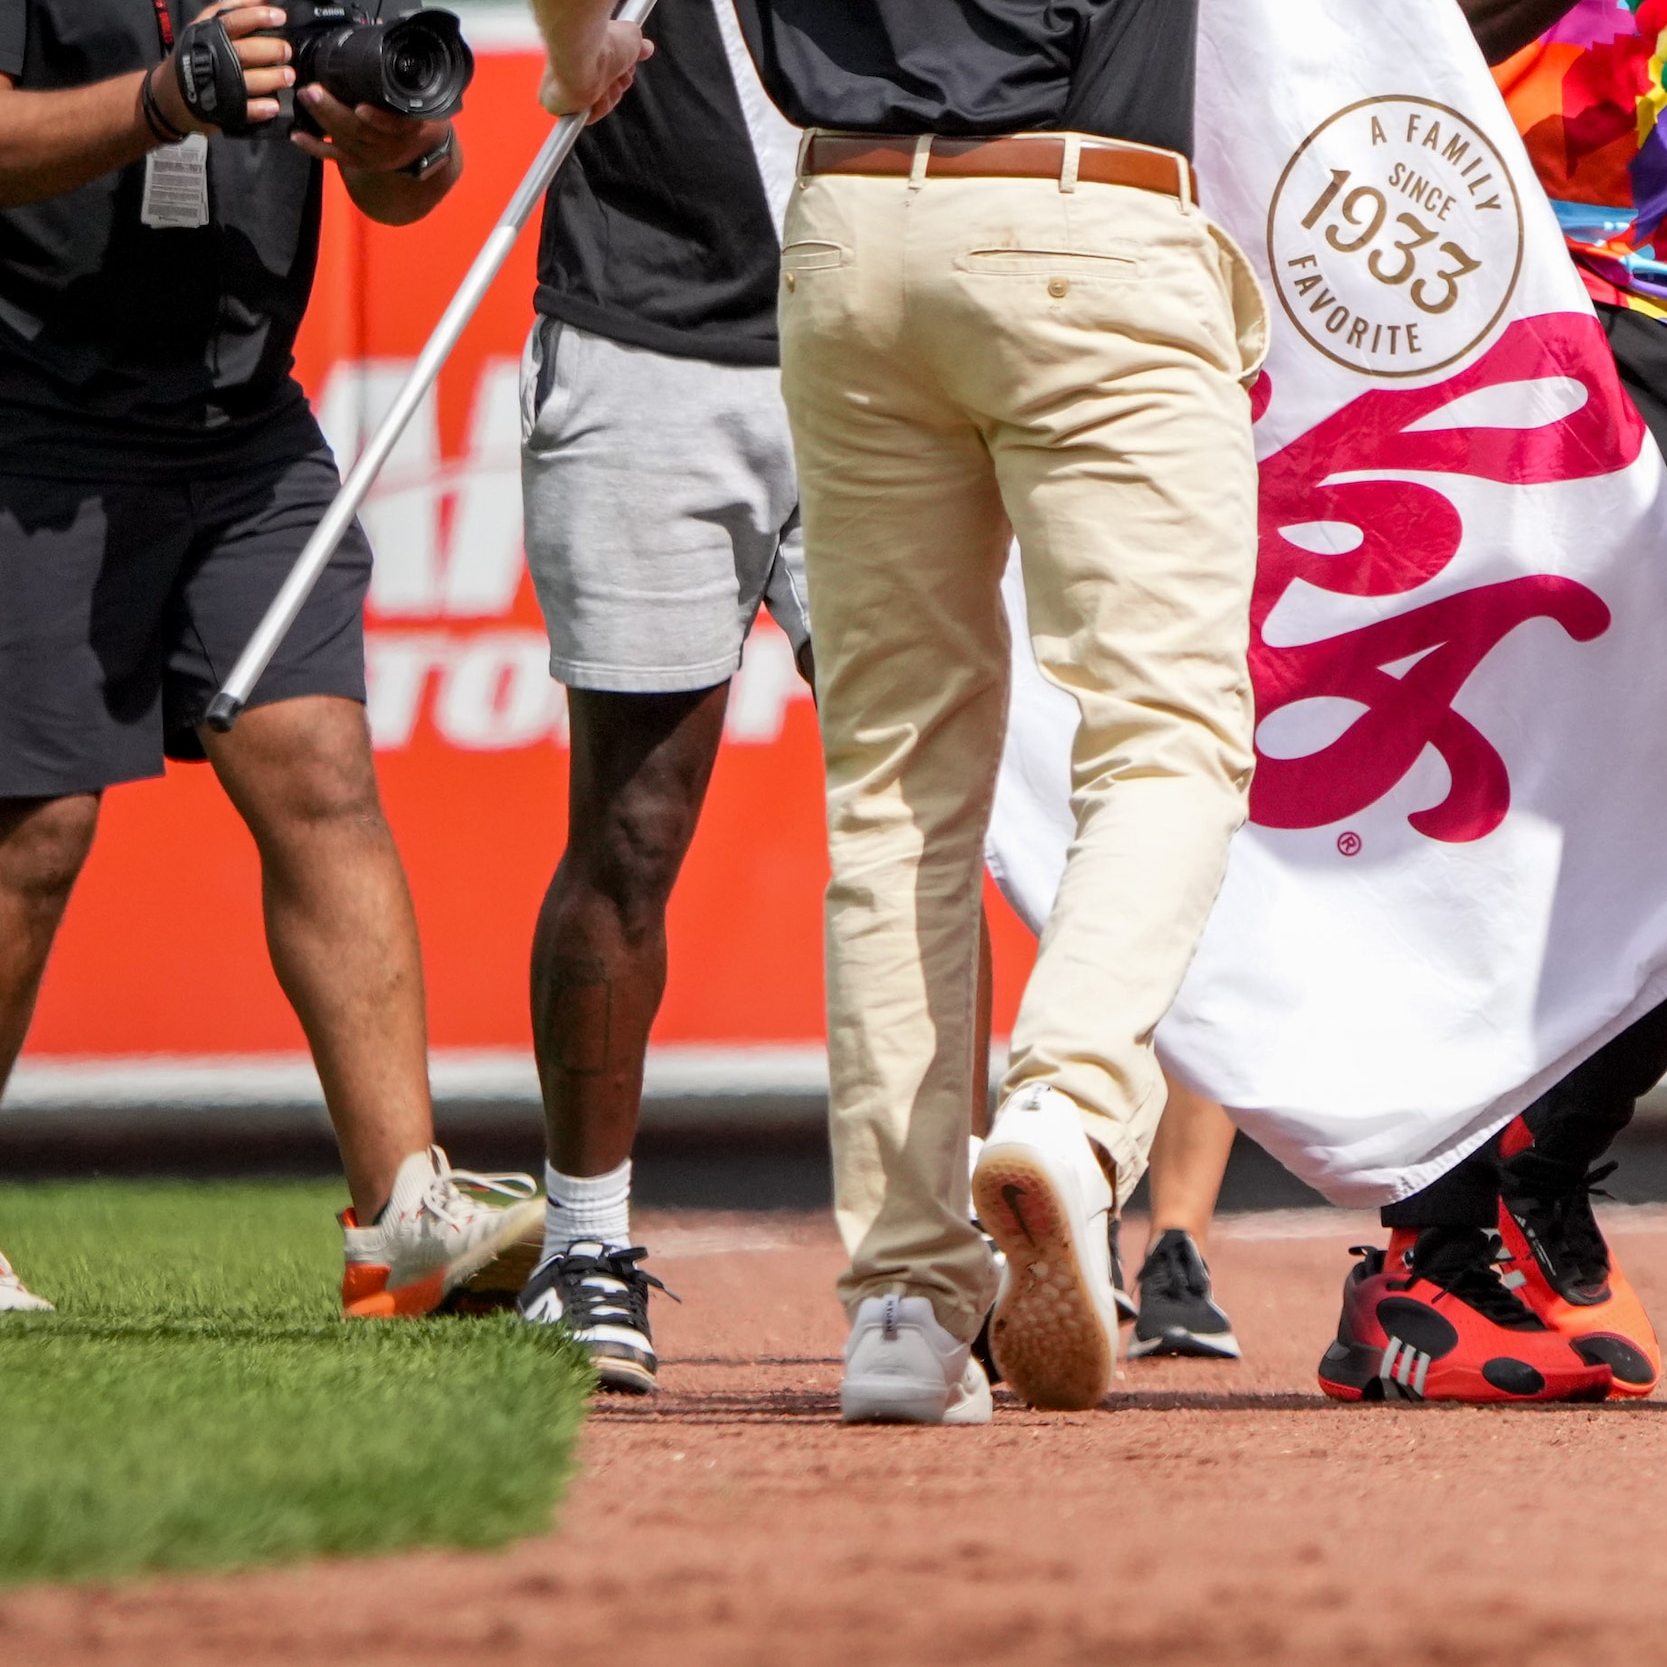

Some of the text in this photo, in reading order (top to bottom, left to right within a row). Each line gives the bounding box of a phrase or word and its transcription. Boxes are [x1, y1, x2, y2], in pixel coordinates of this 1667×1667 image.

[313, 6, 346, 18] Canon
[1370, 113, 1503, 212] A FAMILY
[1388, 161, 1458, 222] SINCE
[1300, 168, 1483, 315] 1933
[1287, 253, 1423, 356] FAVORITE
